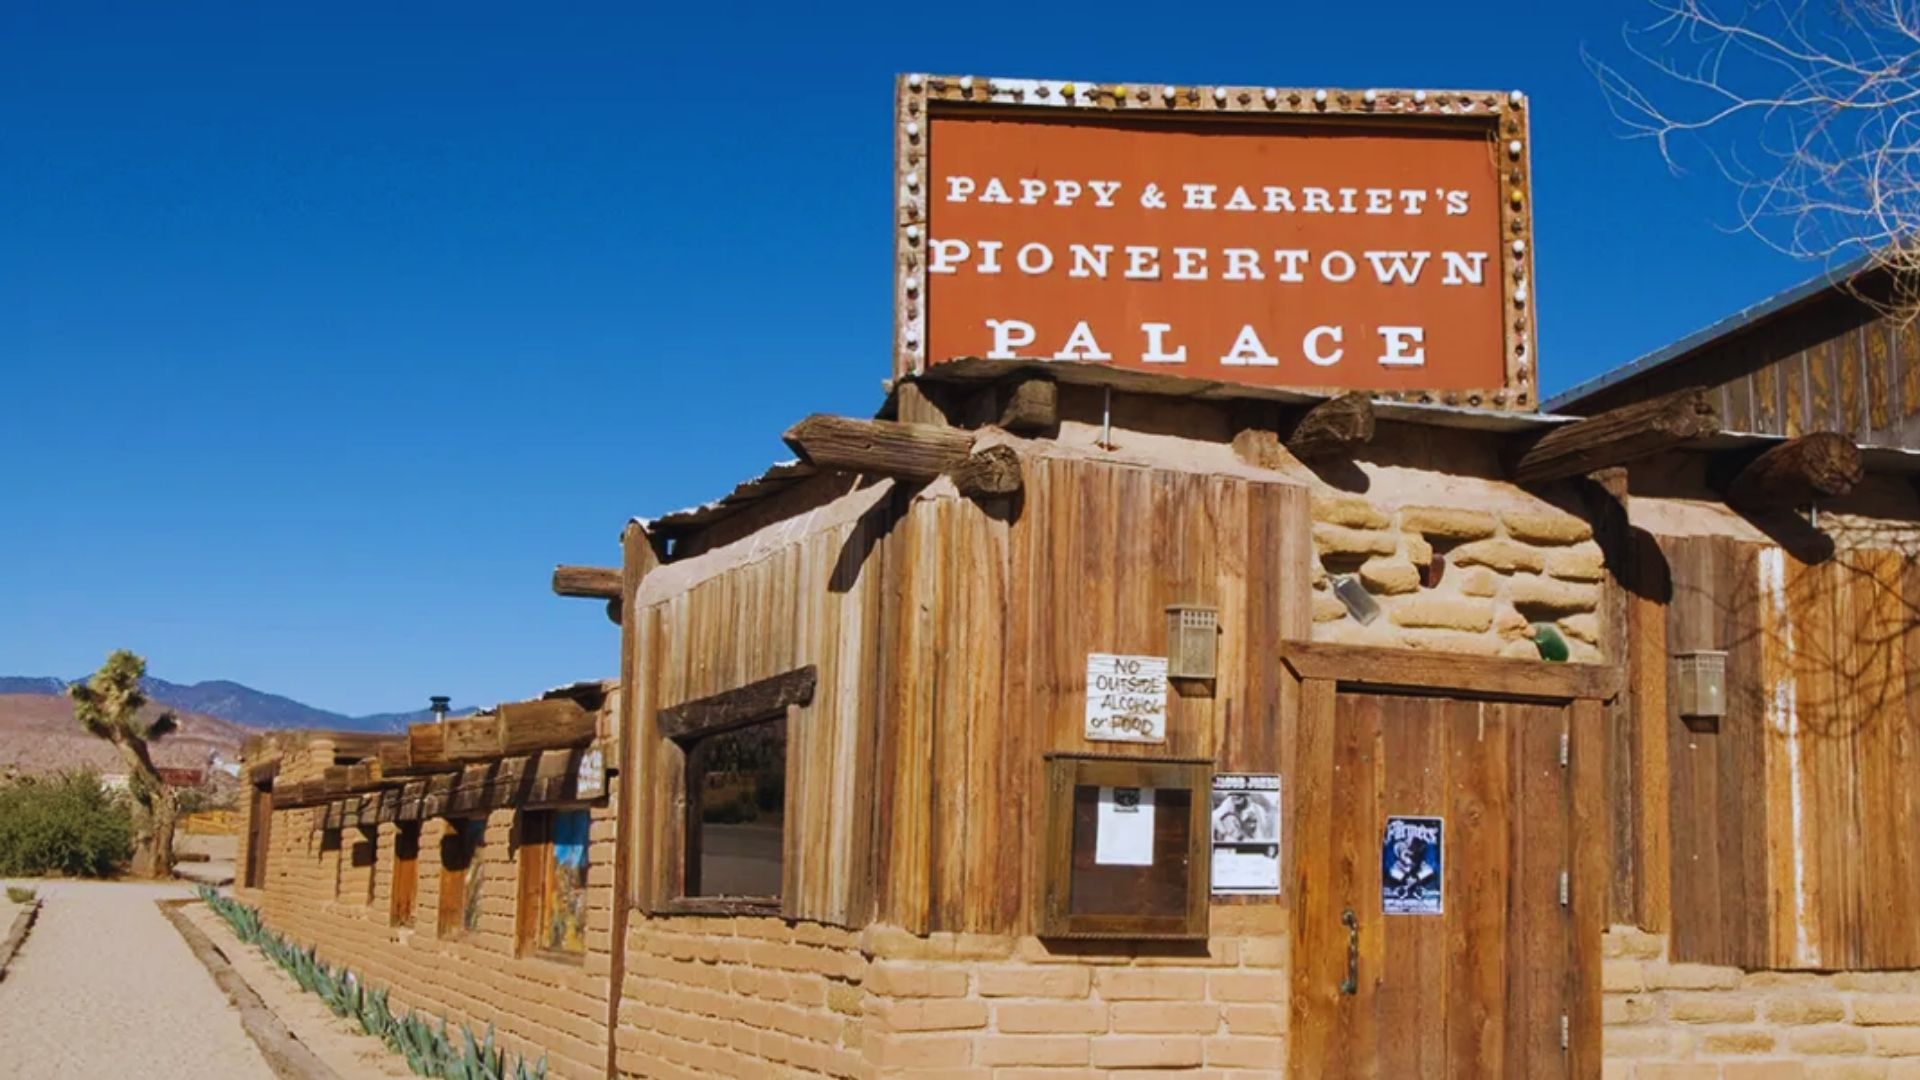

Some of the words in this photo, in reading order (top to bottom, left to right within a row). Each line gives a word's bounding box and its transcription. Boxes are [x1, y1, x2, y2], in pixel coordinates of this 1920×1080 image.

[946, 175, 1122, 207] PAPPY
[1140, 182, 1167, 209] &
[1182, 183, 1470, 215] HARRIET'S
[928, 238, 1488, 286] PIONEERTOWN
[985, 318, 1426, 367] PALACE
[1114, 658, 1140, 675] NO
[1095, 674, 1161, 694] OUTSIDE
[1090, 717, 1108, 729] or
[1111, 714, 1154, 736] FOOD
